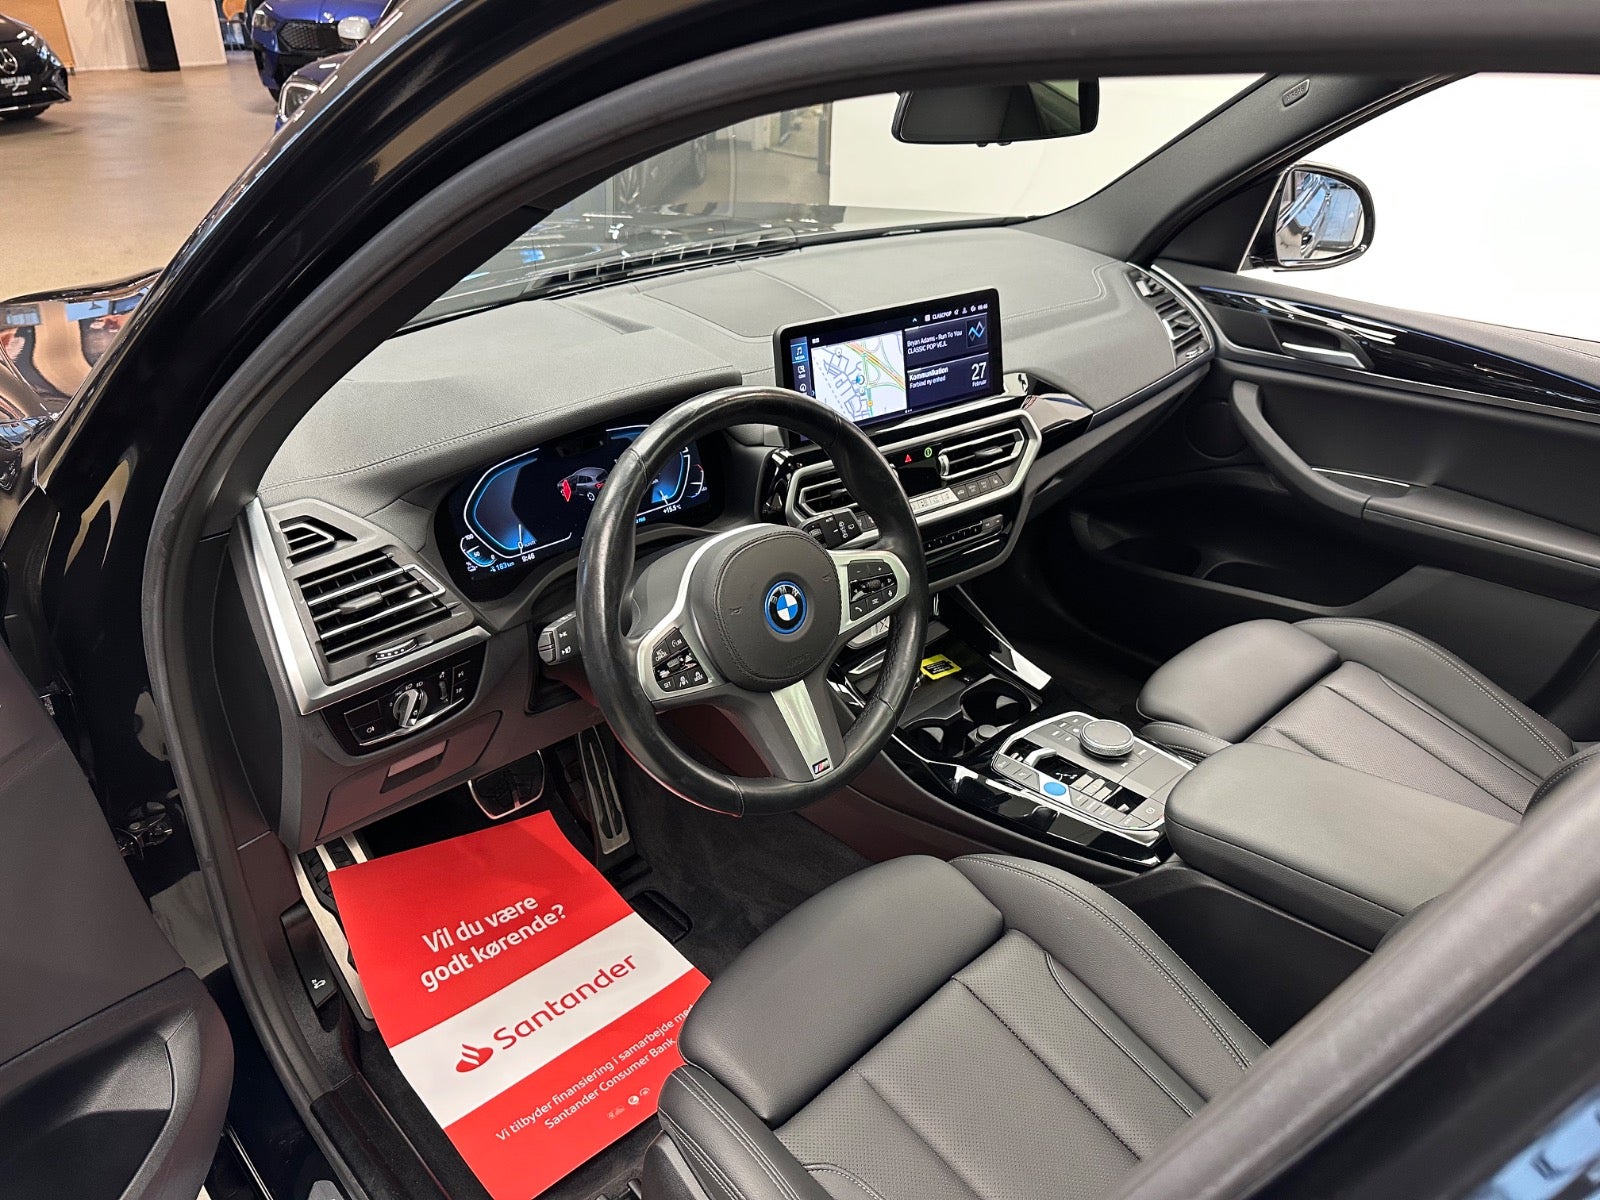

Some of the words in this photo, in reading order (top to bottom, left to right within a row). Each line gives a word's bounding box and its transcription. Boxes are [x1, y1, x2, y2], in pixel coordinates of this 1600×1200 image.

[907, 345, 926, 354] CLASSIC
[926, 343, 937, 351] POP
[921, 335, 935, 344] Adams
[909, 367, 949, 381] Kommunikation
[971, 362, 987, 380] 27
[420, 952, 473, 992] godt
[470, 904, 566, 963] kørende?
[422, 927, 454, 953] Vil
[455, 920, 485, 941] du
[484, 897, 539, 928] være
[493, 955, 637, 1050] Santander
[495, 1128, 510, 1141] Vi
[509, 1101, 553, 1133] tilbyder
[551, 1061, 614, 1105] finansiering
[611, 1056, 619, 1064] i
[618, 1020, 675, 1062] samarbejde
[544, 1088, 600, 1129] Santander
[599, 1054, 650, 1091] Consumer
[649, 1037, 676, 1058] Bank
